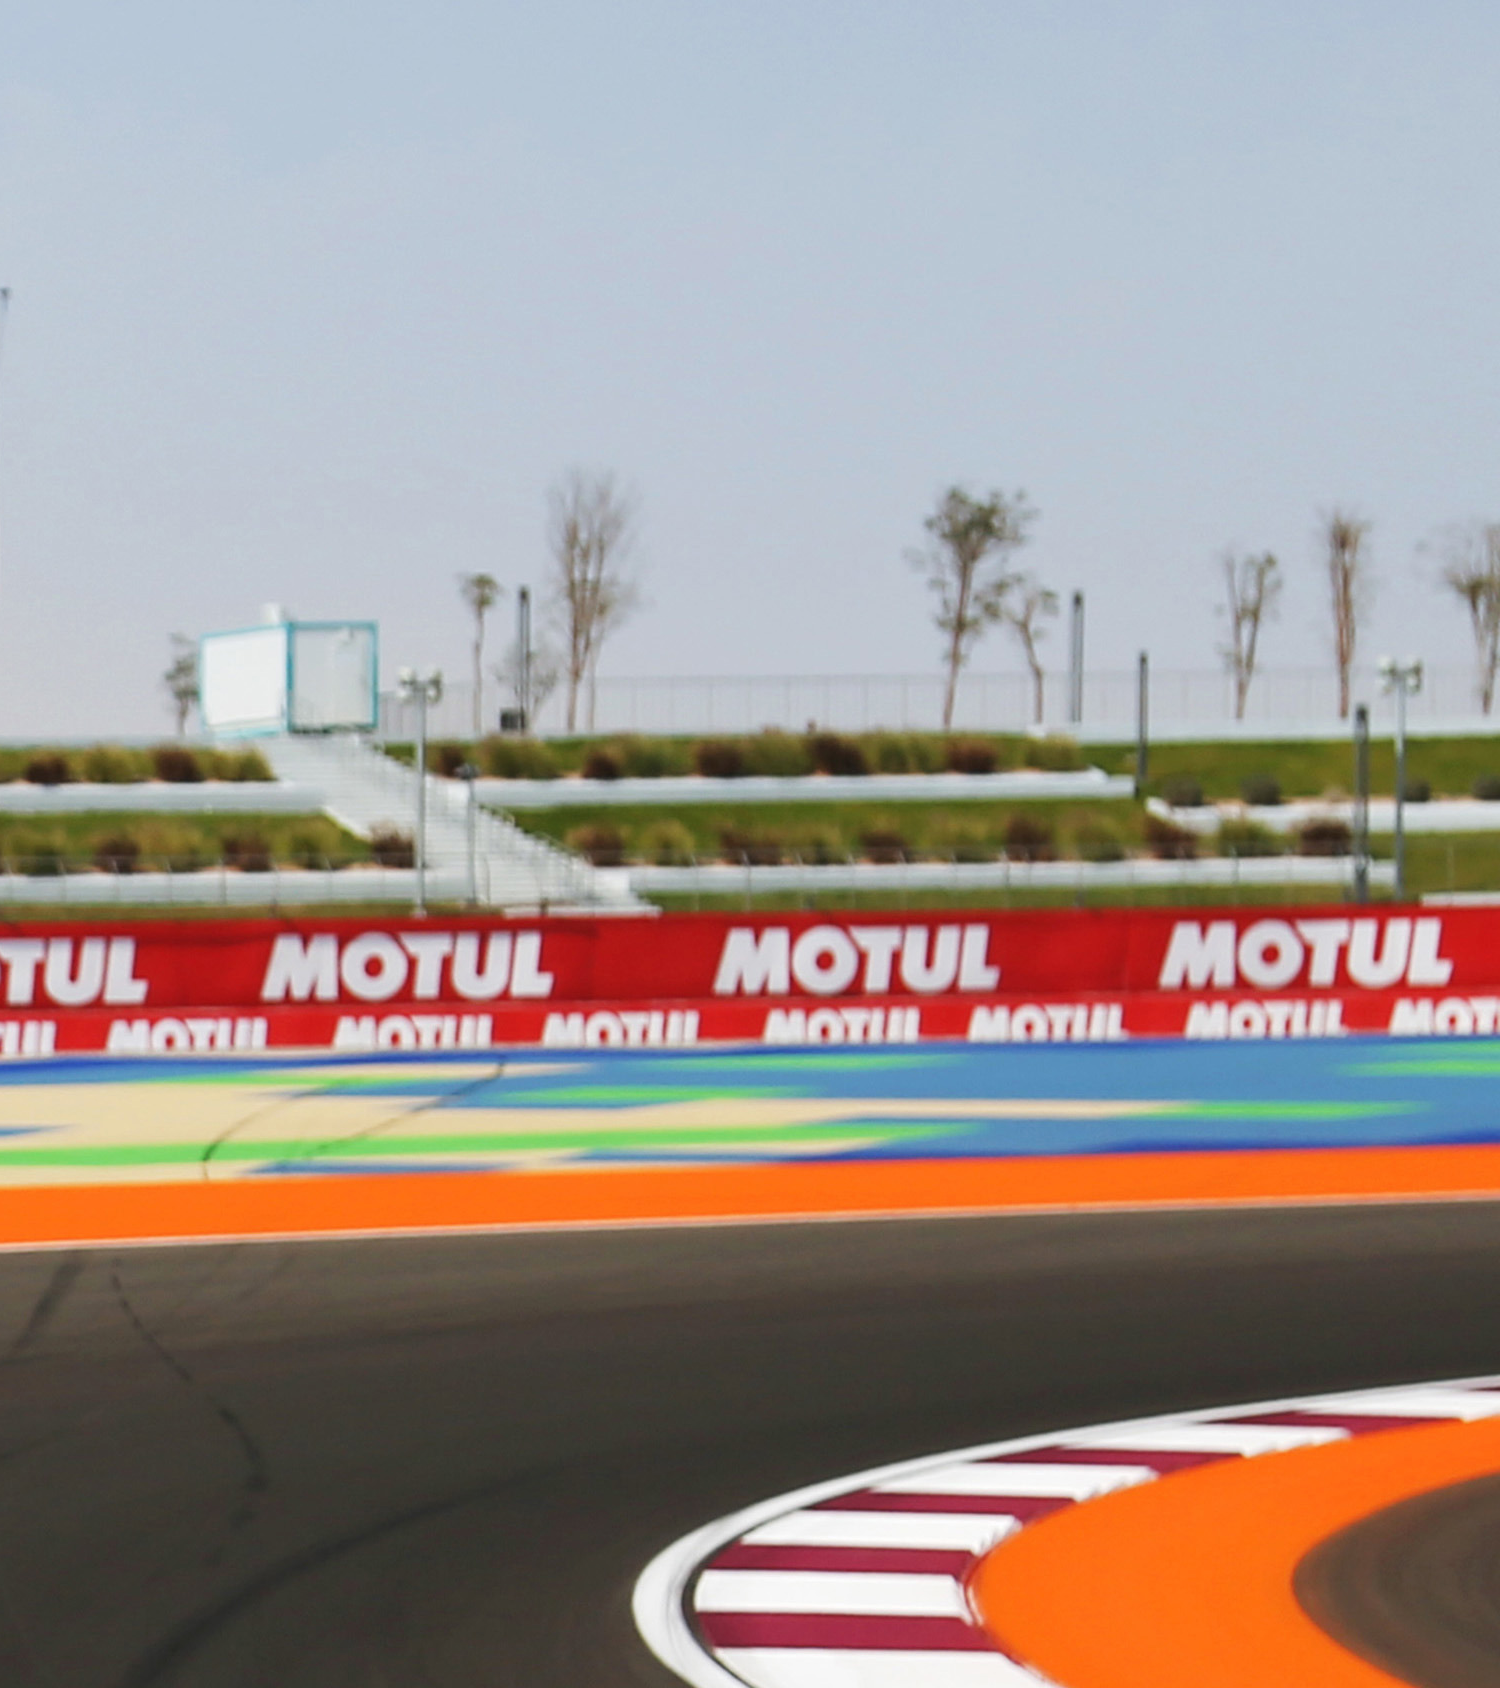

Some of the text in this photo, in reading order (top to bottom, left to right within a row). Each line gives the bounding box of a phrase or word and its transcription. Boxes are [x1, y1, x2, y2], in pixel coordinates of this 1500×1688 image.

[261, 931, 554, 1001] MOTUL
[713, 924, 1000, 995] MOTUL
[1158, 917, 1454, 989] MOTUL
[967, 1003, 1129, 1042] MOTUL
[1184, 999, 1348, 1040] MOTUL
[1387, 996, 1500, 1037] MOT
